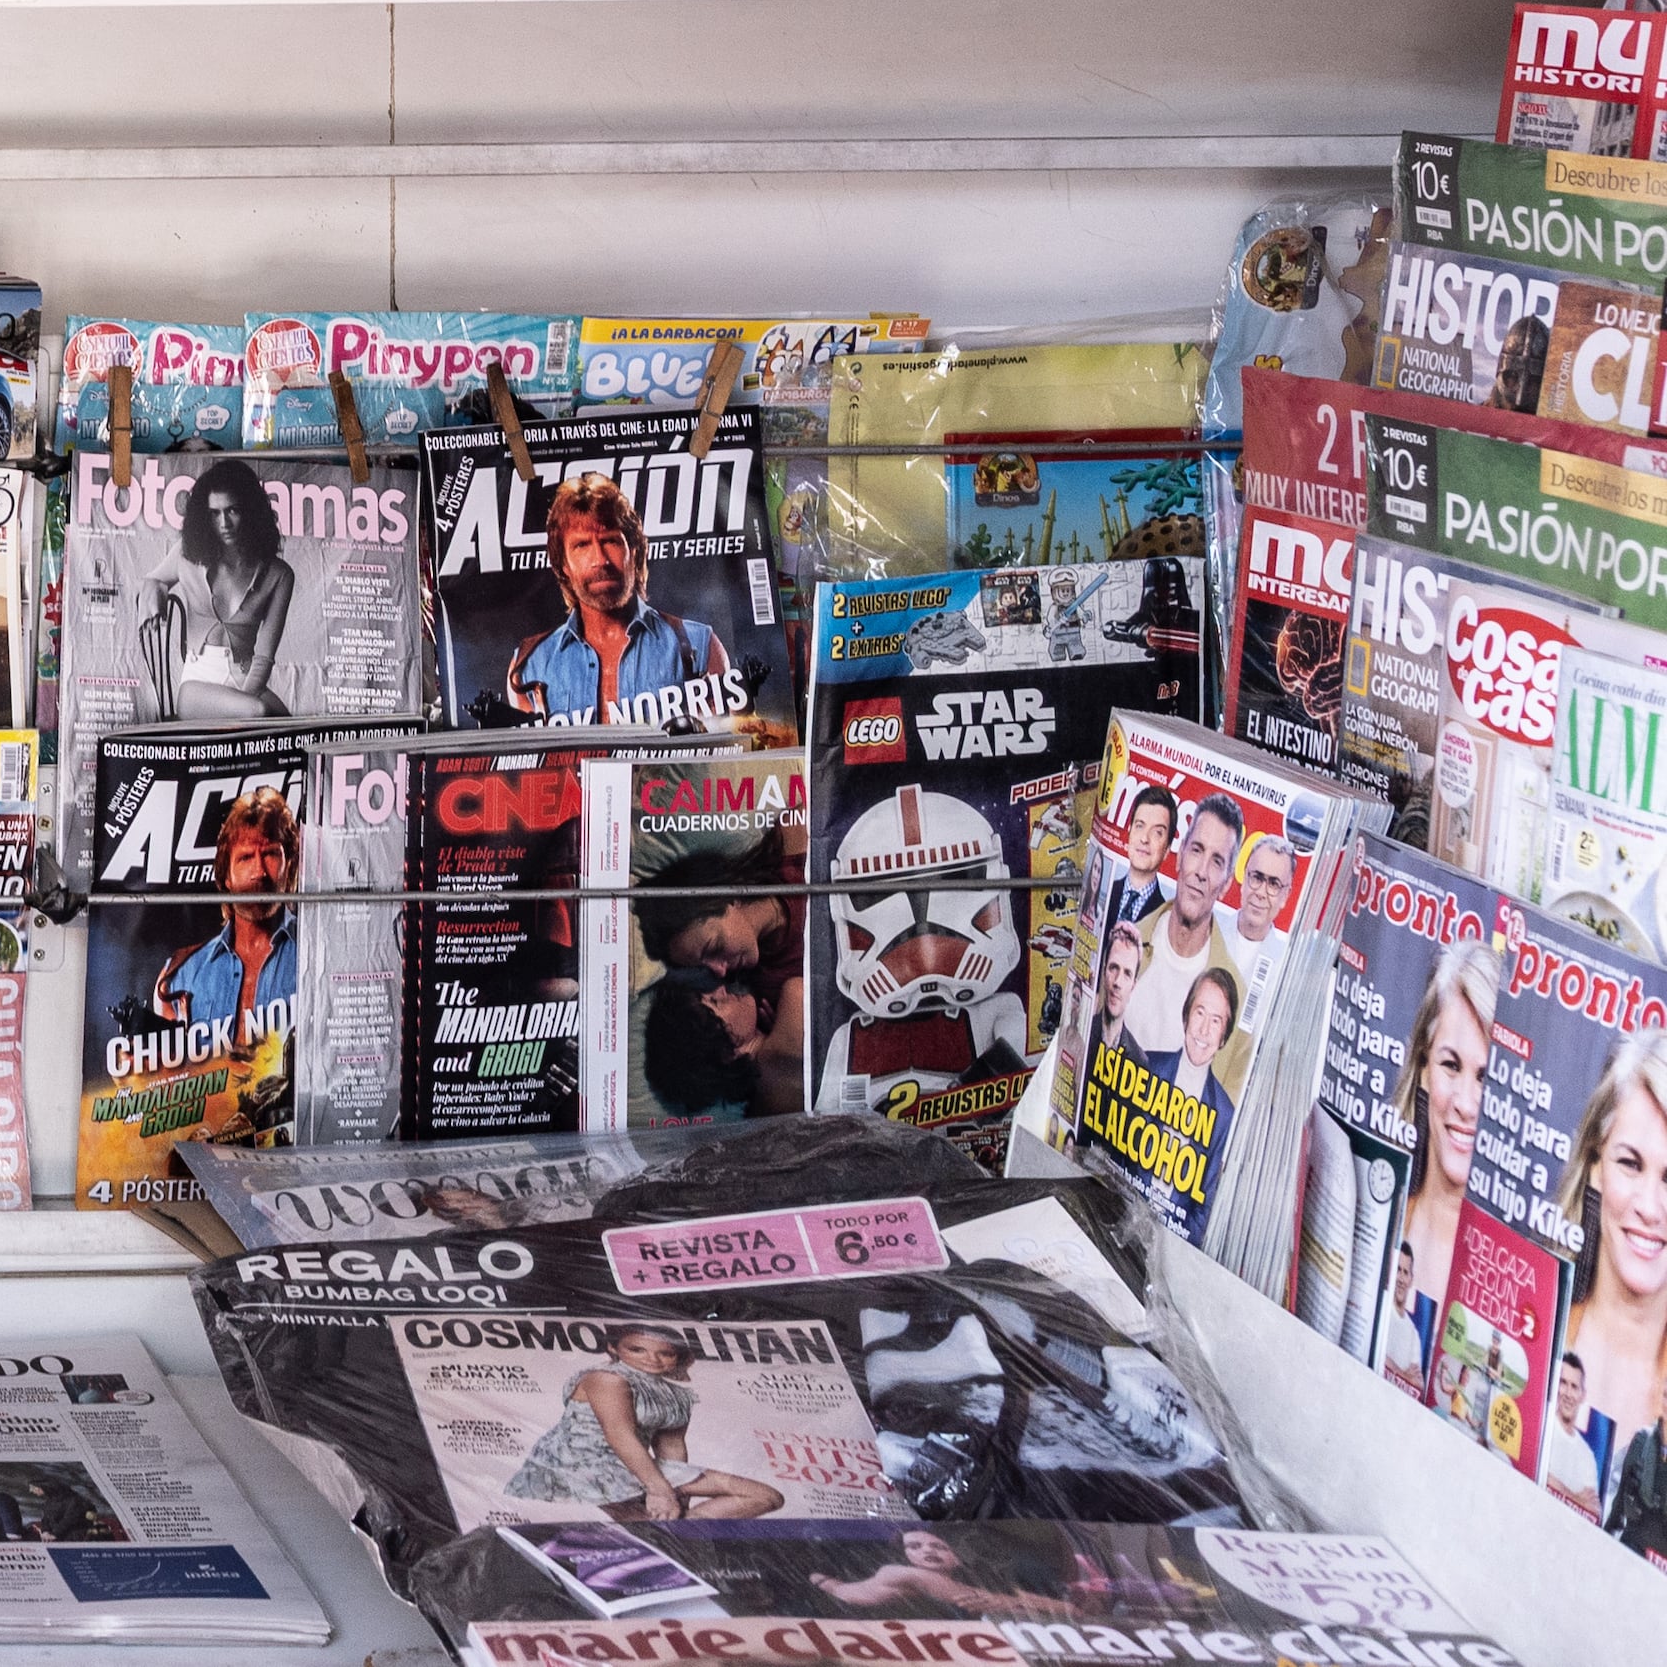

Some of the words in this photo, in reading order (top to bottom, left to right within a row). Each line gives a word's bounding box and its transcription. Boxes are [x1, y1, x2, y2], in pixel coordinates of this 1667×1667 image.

[1467, 198, 1605, 262] PASIÓN
[329, 319, 537, 392] Pinypon
[1401, 348, 1461, 378] NATIONAL
[607, 669, 748, 726] NORRIS
[923, 690, 1043, 727] STAR
[846, 716, 901, 746] LEGO
[916, 723, 1055, 760] WARS
[1351, 869, 1484, 944] pronto
[477, 1040, 546, 1078] GROGU
[235, 1240, 535, 1286] REGALO
[638, 1230, 776, 1261] REVISTA
[485, 1620, 746, 1667] marie
[762, 1618, 1014, 1665] claire
